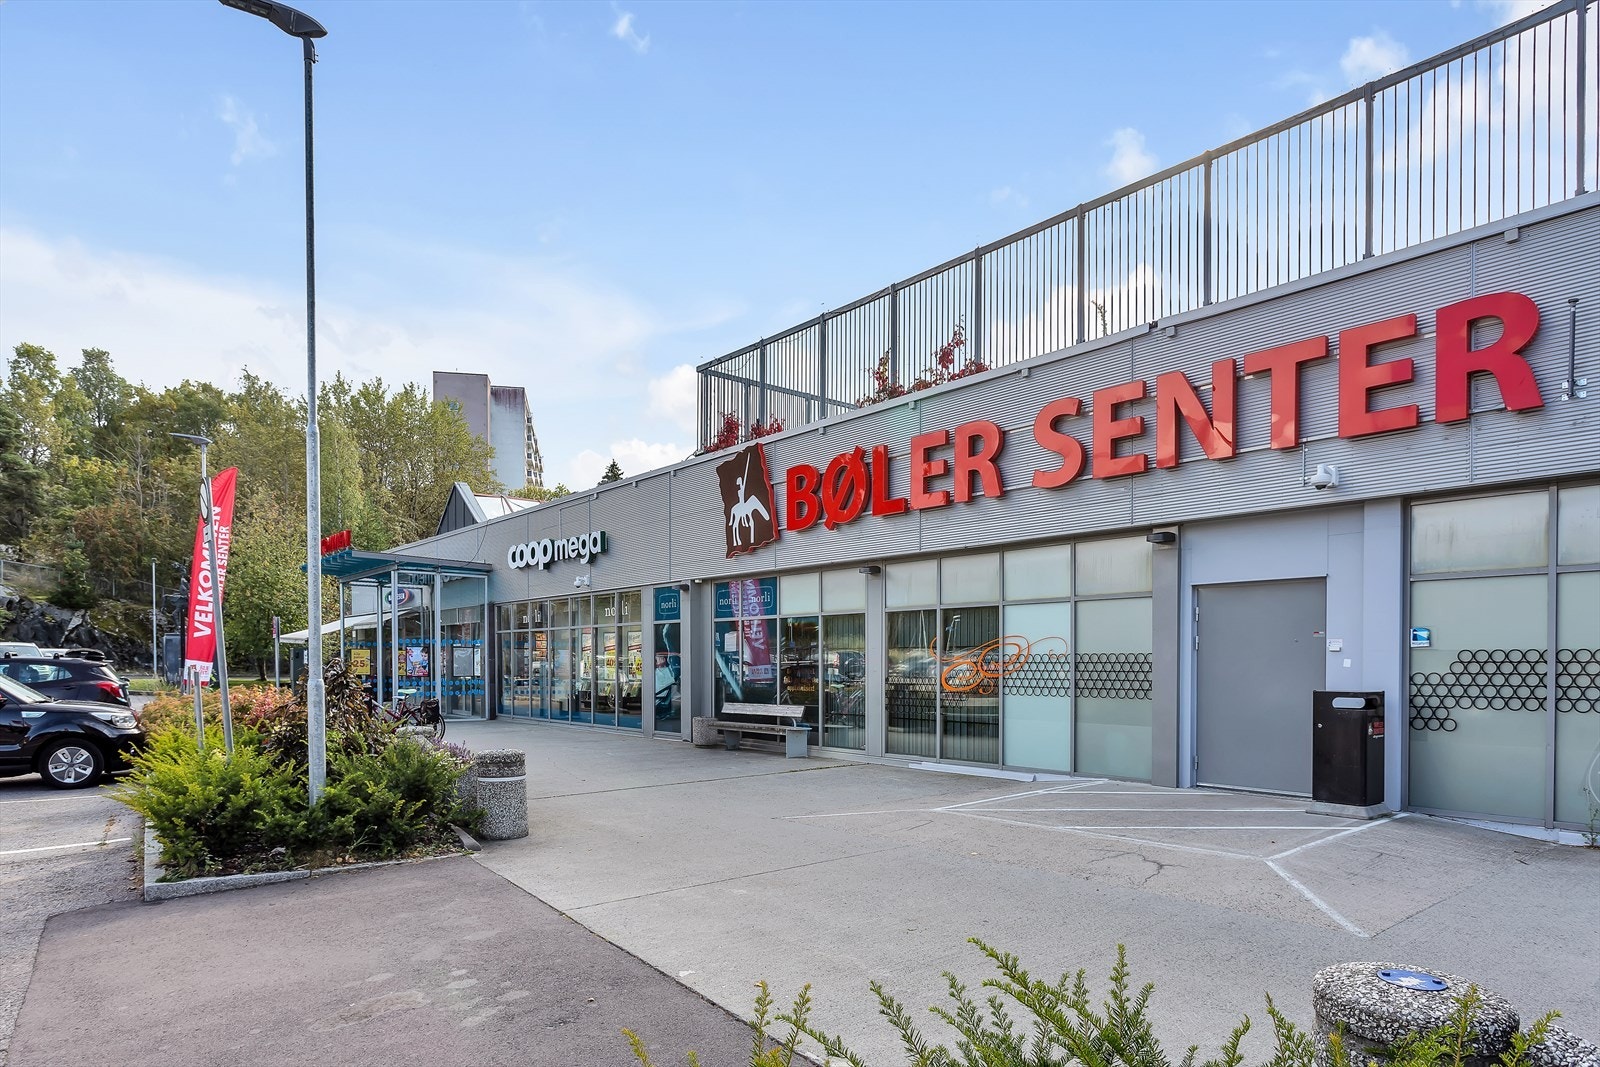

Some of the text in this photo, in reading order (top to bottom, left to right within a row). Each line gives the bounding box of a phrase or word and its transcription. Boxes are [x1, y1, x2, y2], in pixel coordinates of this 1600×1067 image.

[786, 291, 1545, 532] BØLER SENTER
[217, 525, 230, 566] SENTER
[507, 530, 603, 570] coop mega
[604, 600, 629, 617] noli
[660, 598, 677, 609] norli
[751, 591, 771, 603] norli
